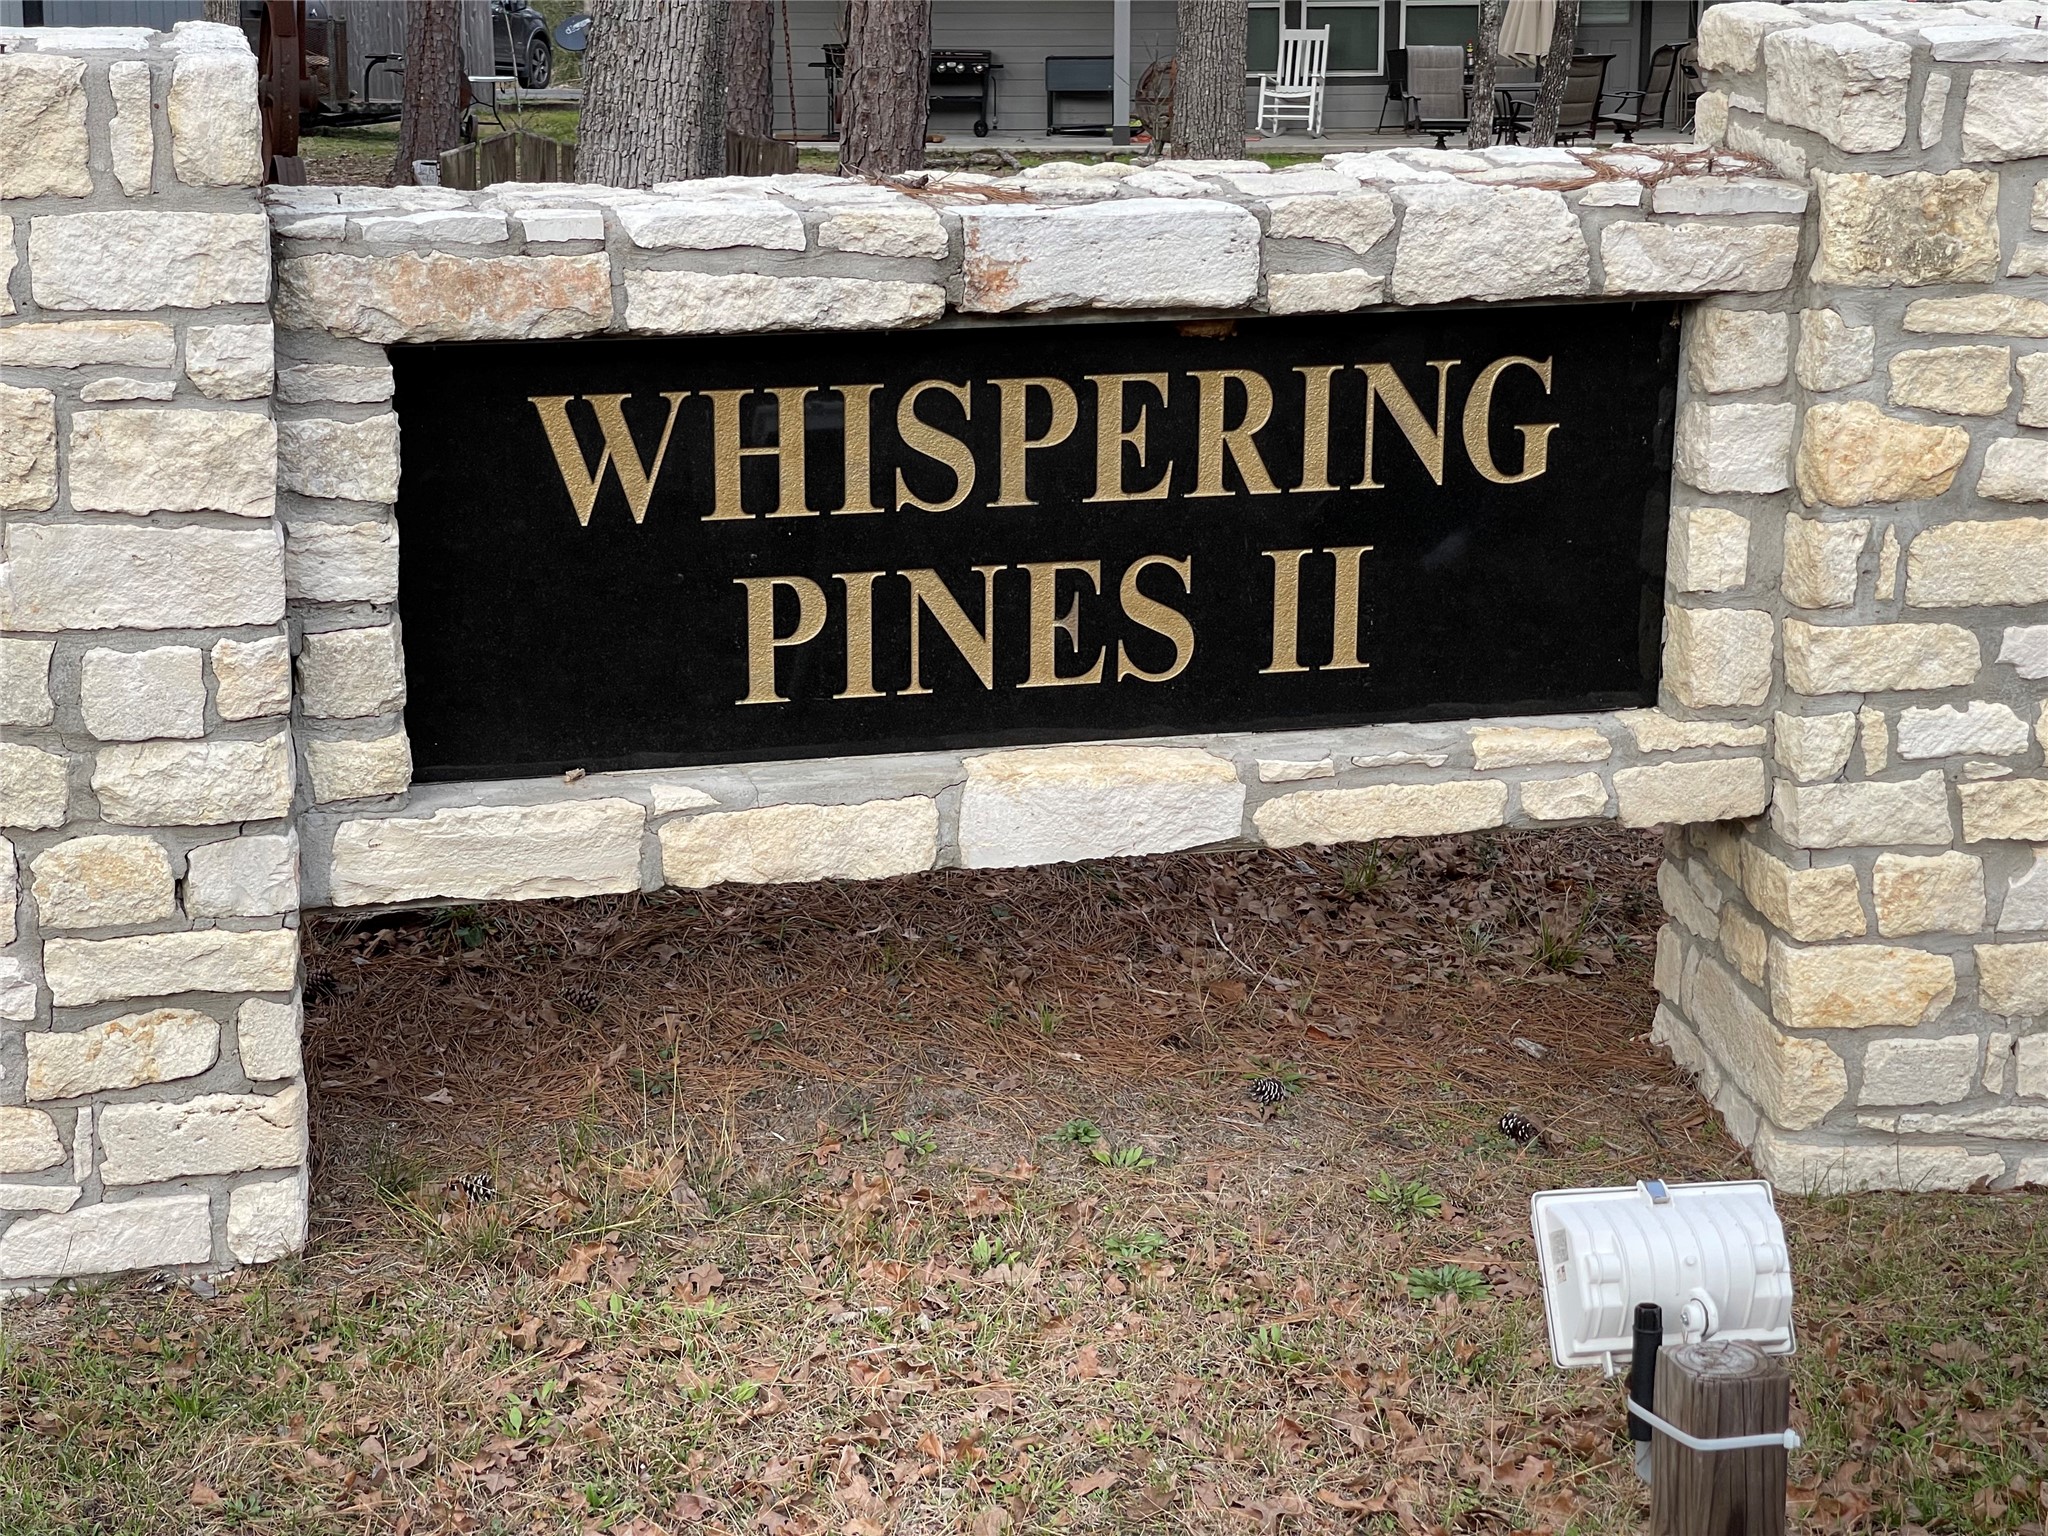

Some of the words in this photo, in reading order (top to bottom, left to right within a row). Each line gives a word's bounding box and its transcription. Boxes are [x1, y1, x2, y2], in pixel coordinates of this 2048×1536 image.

[527, 355, 1560, 527] WHISPERING
[732, 554, 1195, 706] PINES
[1258, 545, 1374, 674] II
